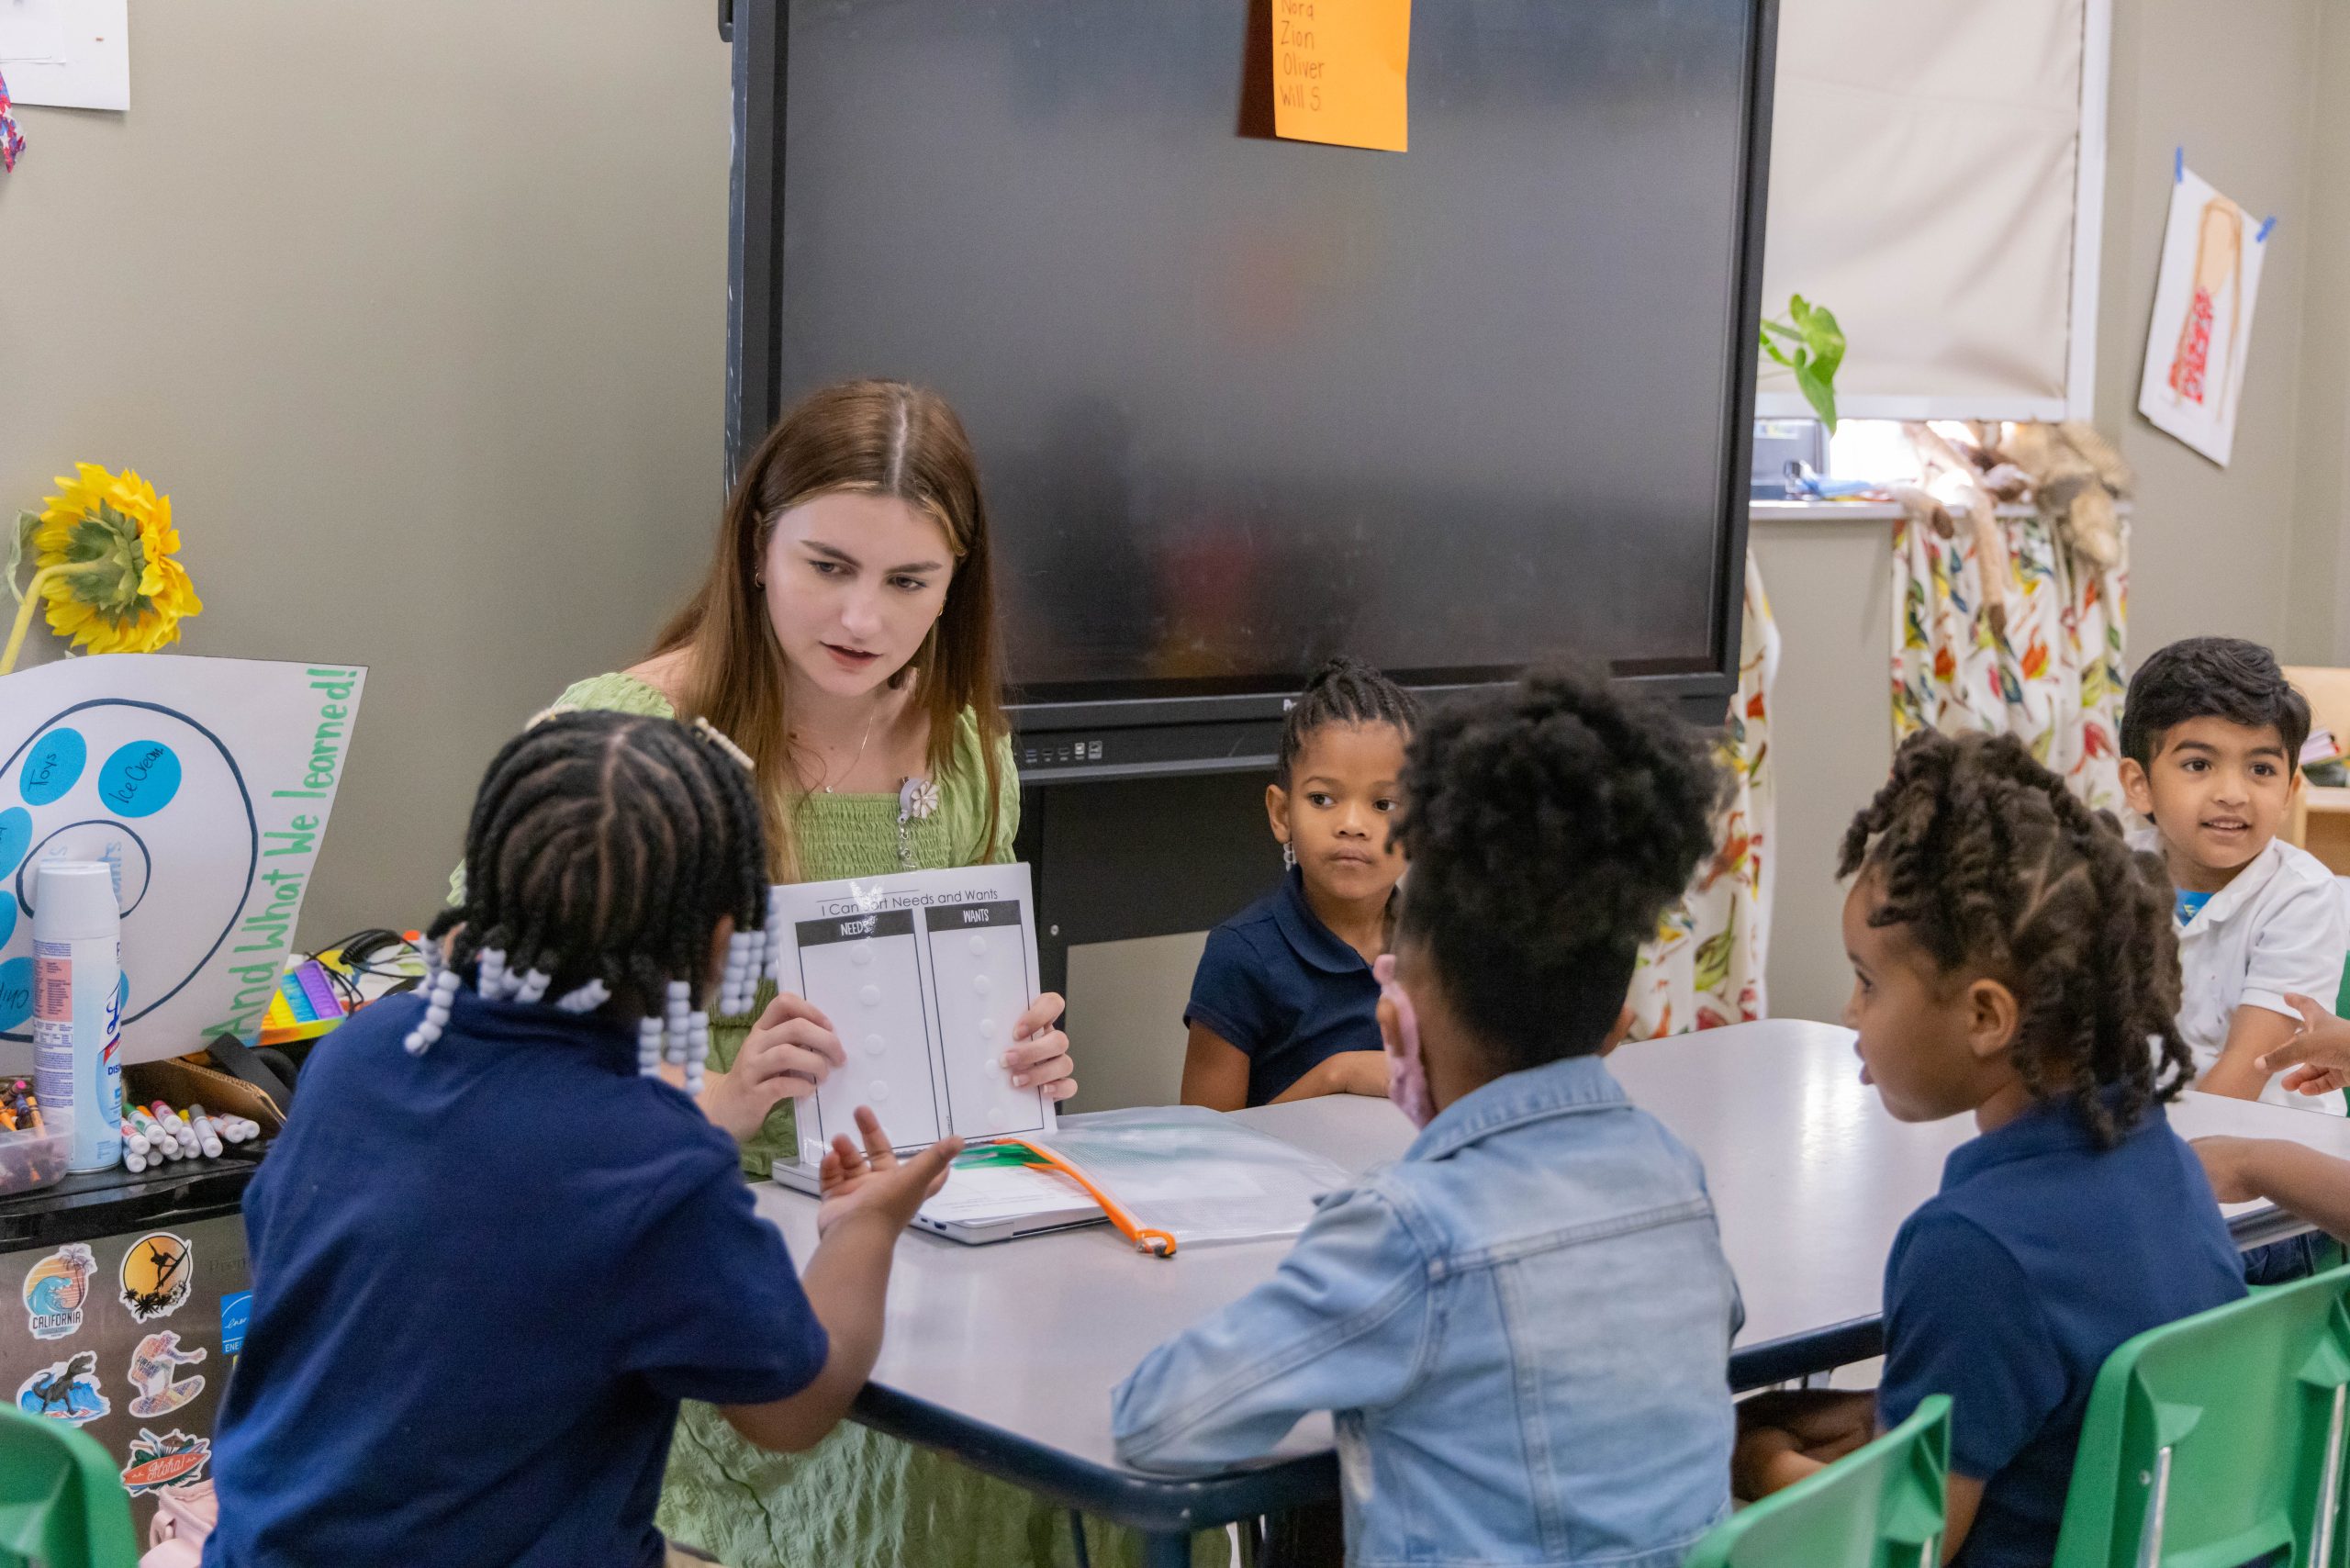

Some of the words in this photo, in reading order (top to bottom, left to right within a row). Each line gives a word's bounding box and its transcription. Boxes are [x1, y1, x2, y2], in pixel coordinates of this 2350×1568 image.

[1281, 20, 1315, 50] Zion
[1283, 52, 1325, 80] Oliver
[1279, 84, 1304, 109] Will
[1309, 86, 1322, 111] S
[28, 753, 58, 792] Toys
[108, 780, 138, 804] Ice
[263, 814, 320, 857] We
[233, 868, 305, 953] What
[822, 905, 825, 916] I
[829, 901, 859, 916] Can
[892, 893, 934, 909] Needs
[938, 889, 963, 903] and
[966, 888, 998, 901] Wants
[840, 920, 869, 936] NEEDS
[963, 909, 990, 924] WANTS
[201, 961, 279, 1037] And
[32, 1311, 81, 1329] CALIFORNIA
[147, 1455, 185, 1481] Aloha!
